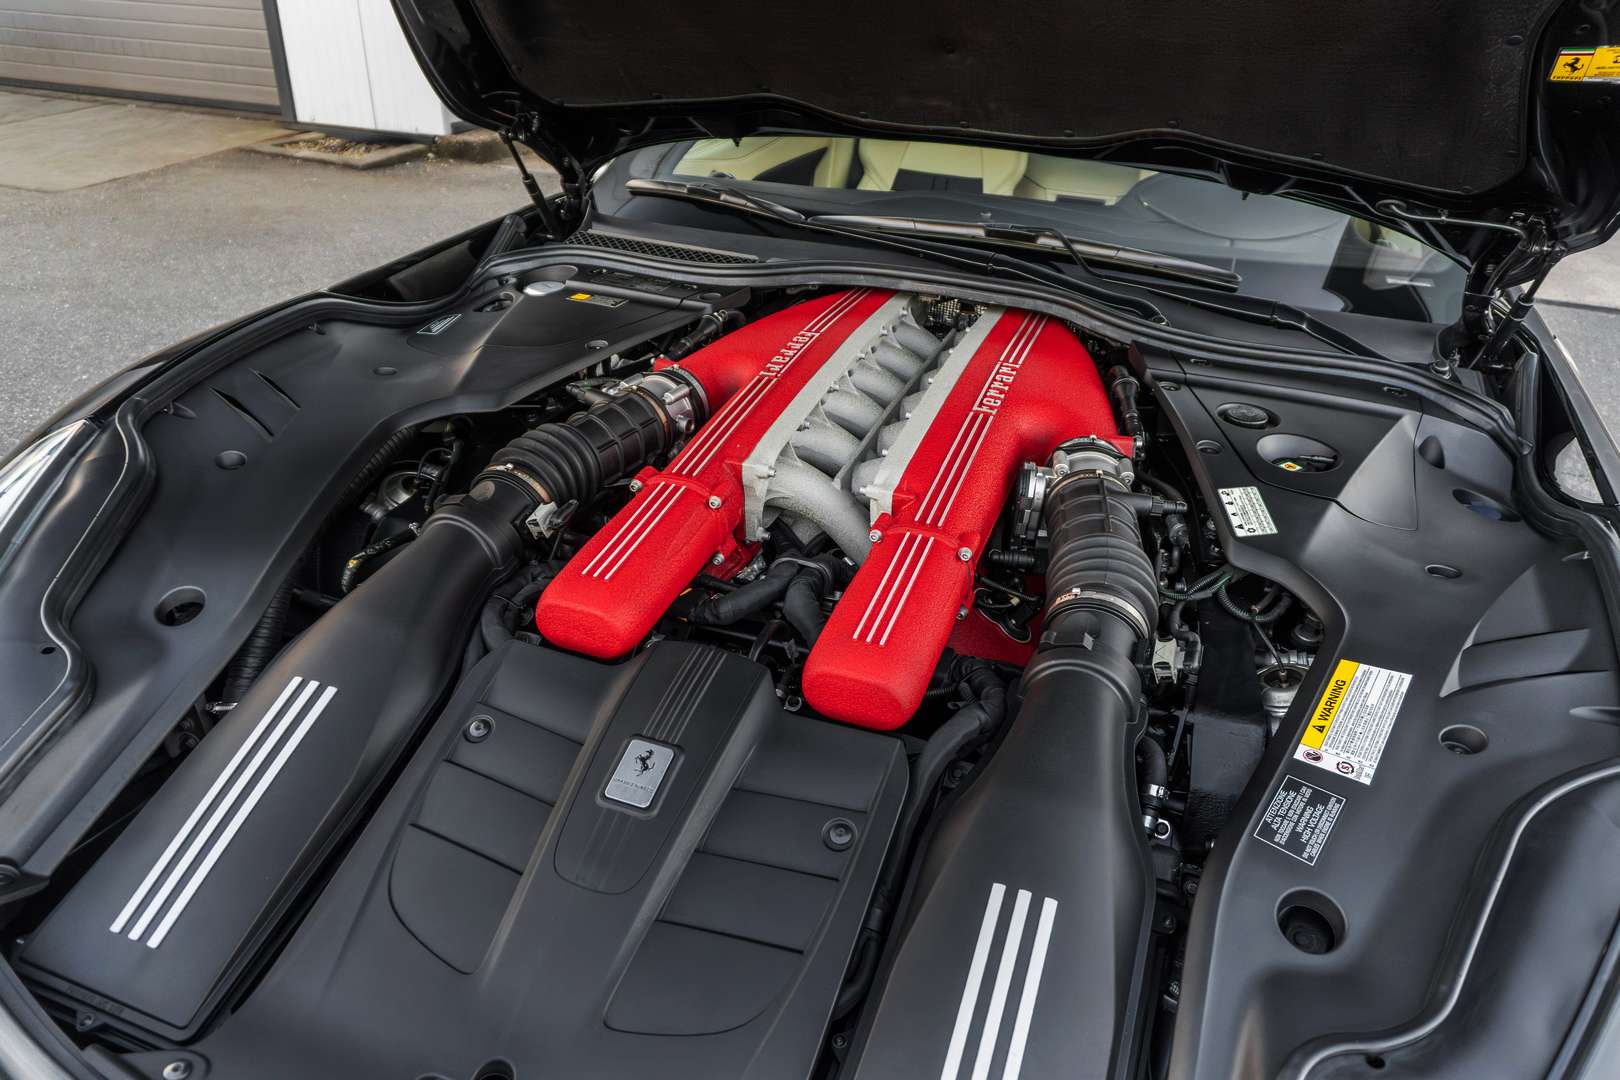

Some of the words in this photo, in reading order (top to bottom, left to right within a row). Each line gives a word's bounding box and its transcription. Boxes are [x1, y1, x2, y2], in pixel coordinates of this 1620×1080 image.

[974, 362, 1019, 415] Ferrari
[1317, 679, 1346, 722] WARNING
[1270, 815, 1282, 830] ALTA
[1294, 805, 1314, 833] WARNING
[1299, 826, 1312, 843] HIGH
[1307, 803, 1325, 828] VOLTAGE
